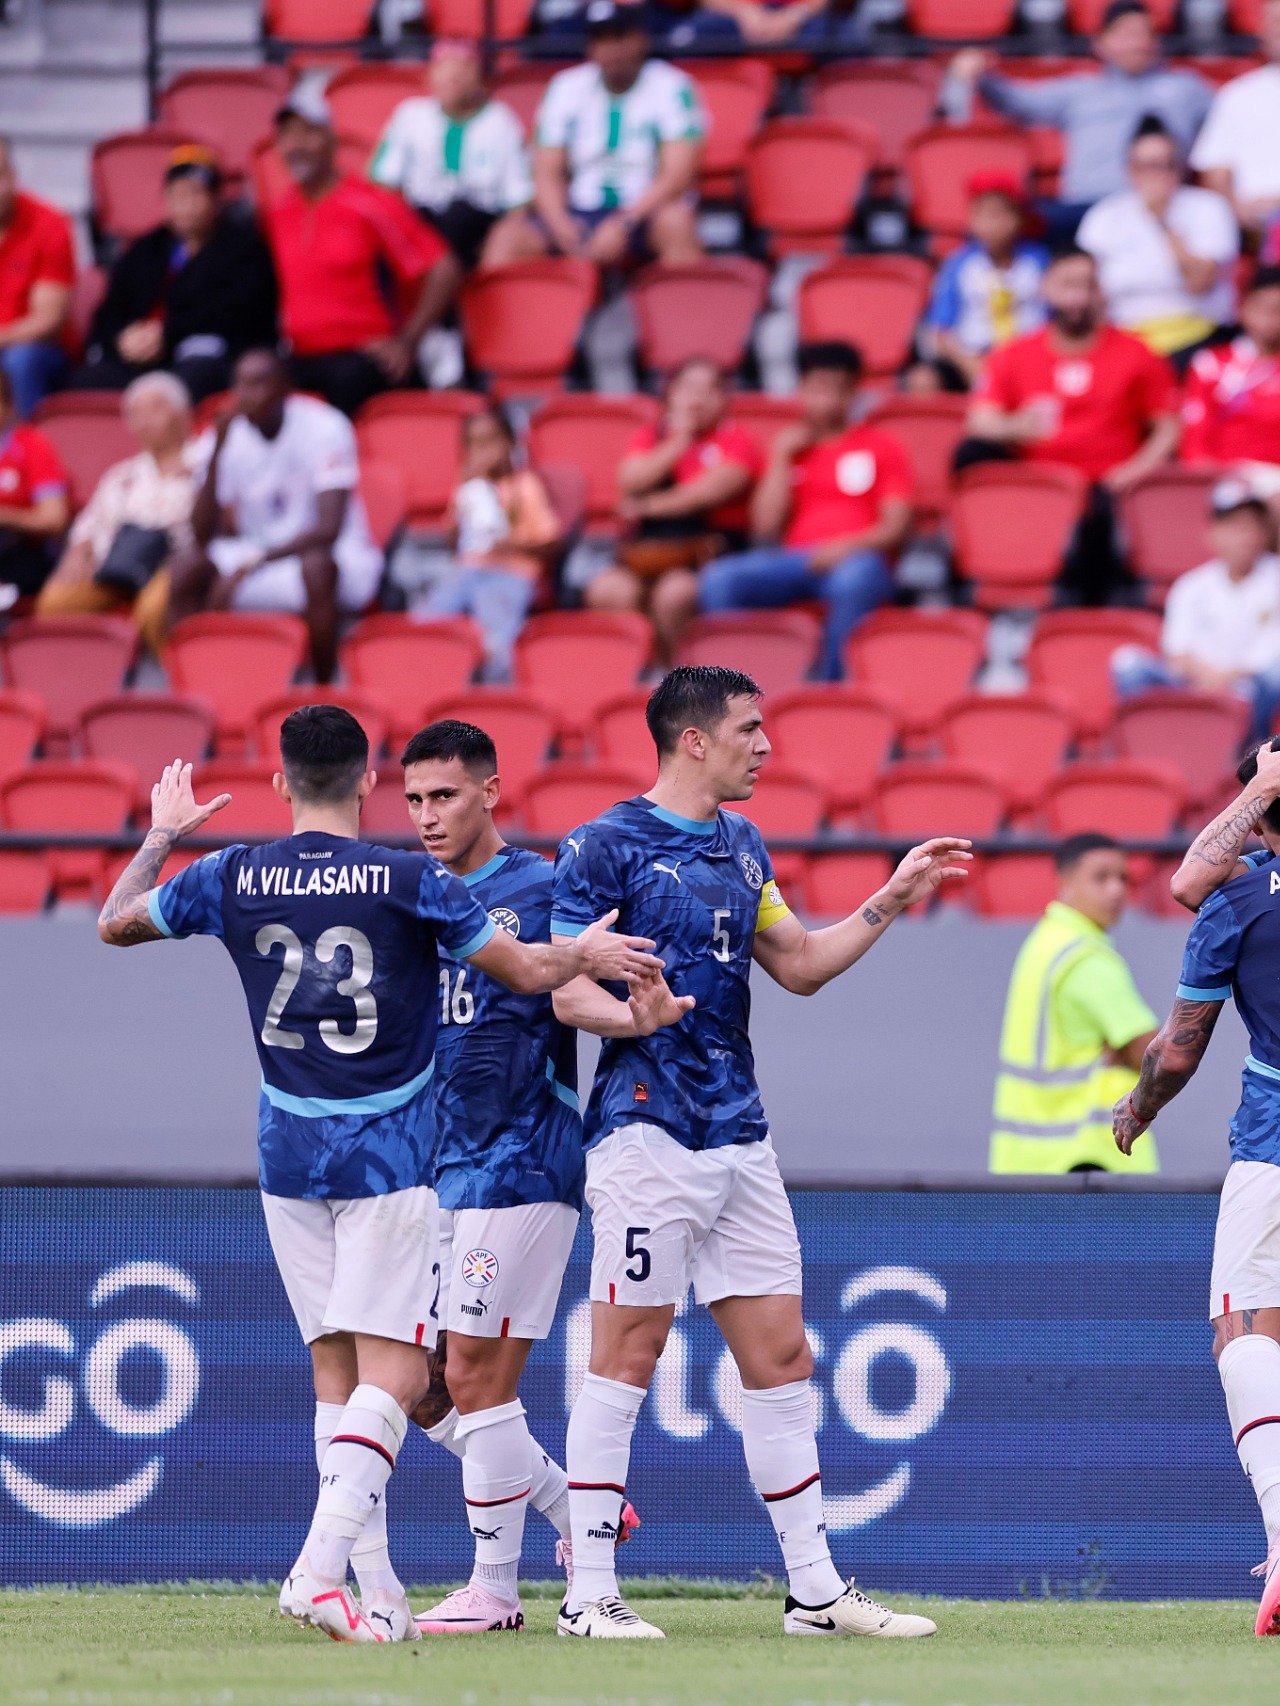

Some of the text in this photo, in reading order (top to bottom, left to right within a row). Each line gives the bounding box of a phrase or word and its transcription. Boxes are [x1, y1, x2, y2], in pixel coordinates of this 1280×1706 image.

[299, 852, 333, 860] PARAGUAY
[237, 864, 390, 896] M. VILLASANTI
[713, 909, 731, 962] 5
[256, 923, 378, 1054] 23
[439, 968, 475, 1025] 16
[475, 1251, 488, 1259] APF
[625, 1227, 651, 1283] 5
[461, 1304, 483, 1317] PUMA
[321, 1474, 340, 1488] PF
[587, 1529, 617, 1540] PUMA
[817, 1522, 827, 1533] PU
